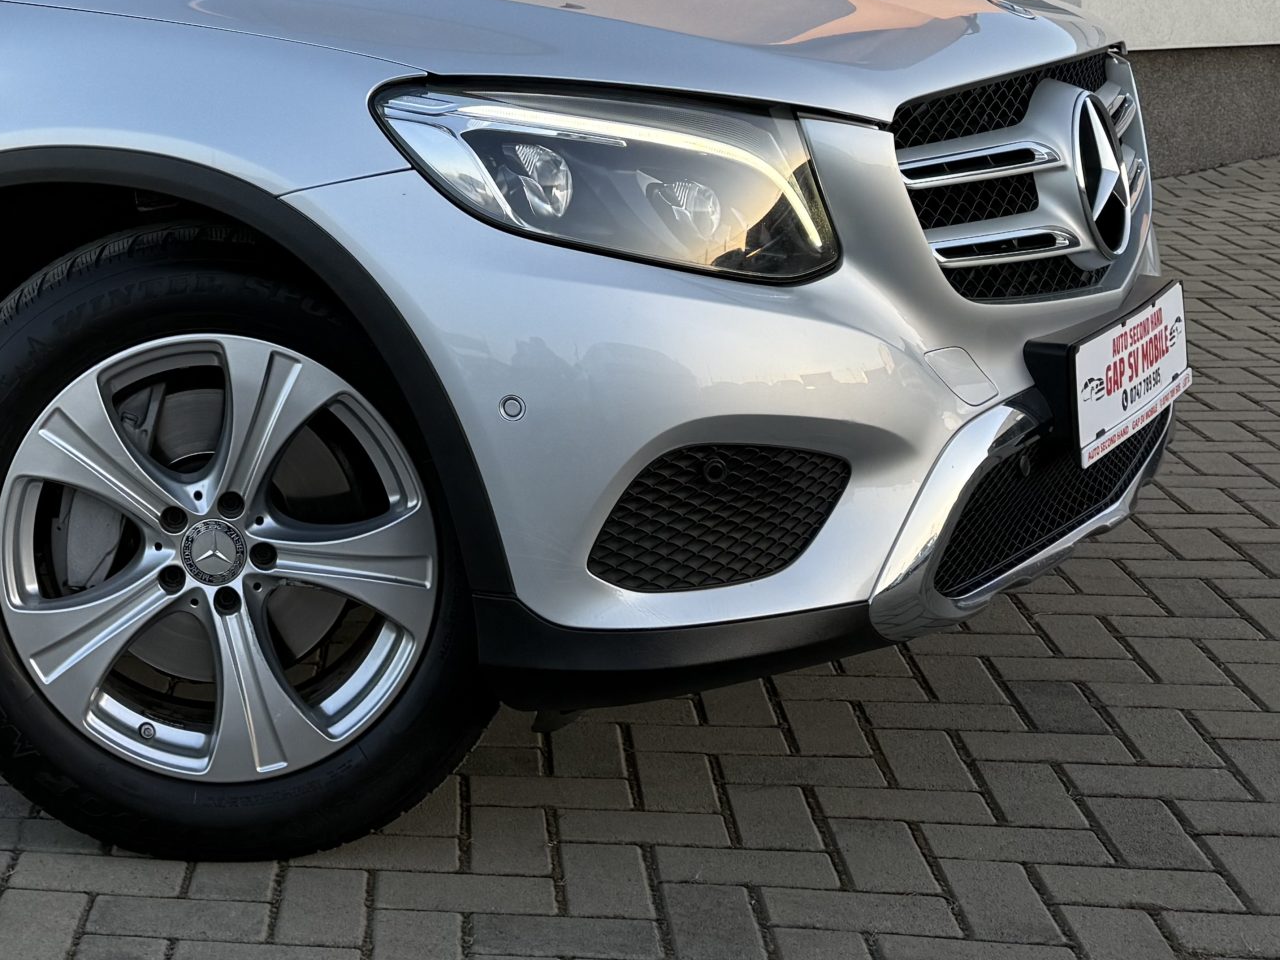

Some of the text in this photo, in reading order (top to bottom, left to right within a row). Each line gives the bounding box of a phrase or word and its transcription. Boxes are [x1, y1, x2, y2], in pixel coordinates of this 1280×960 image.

[1112, 330, 1128, 358] AUTO
[1129, 317, 1150, 347] SECOND
[1105, 357, 1125, 397] GAP
[1128, 345, 1139, 382] SV
[1141, 325, 1169, 373] MOBILE
[183, 541, 210, 582] MERCEDES
